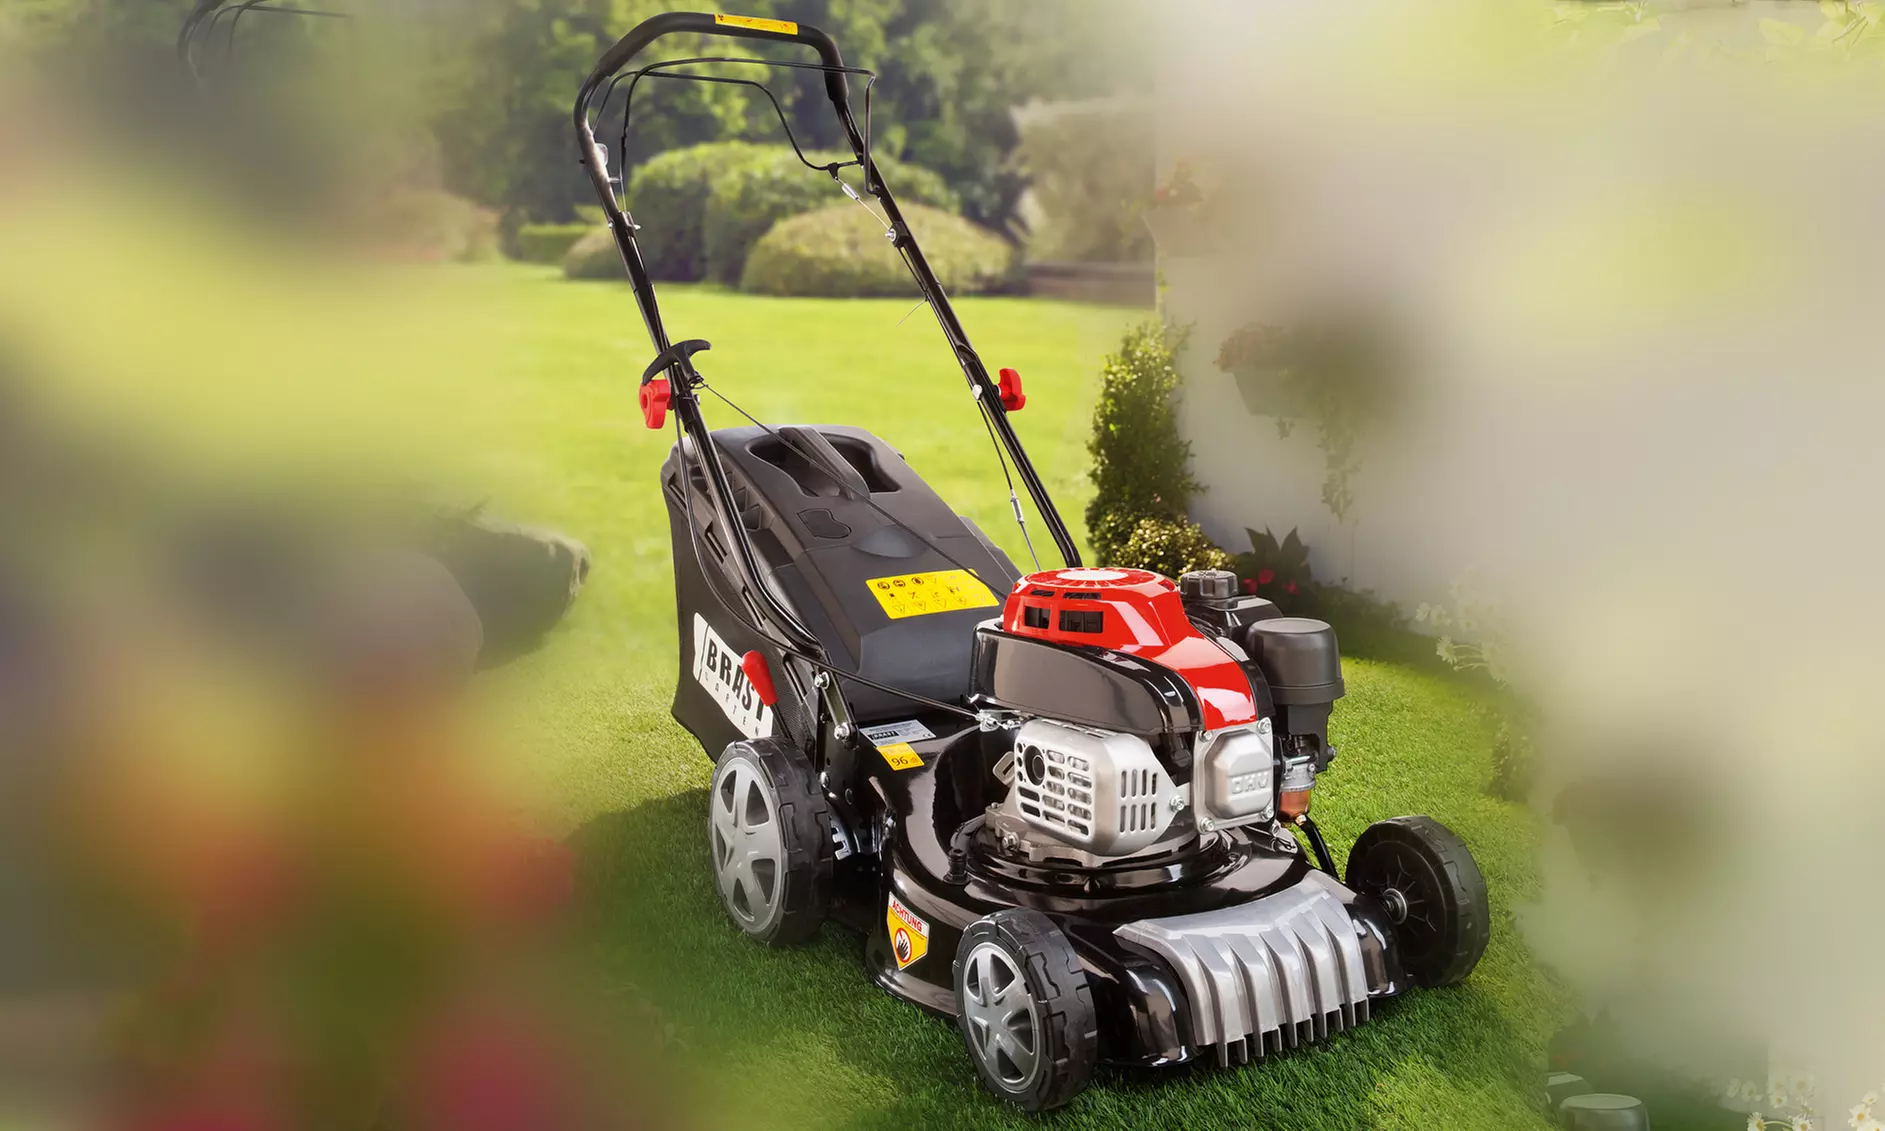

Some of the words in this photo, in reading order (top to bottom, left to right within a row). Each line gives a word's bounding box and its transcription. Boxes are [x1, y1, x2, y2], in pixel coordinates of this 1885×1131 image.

[891, 756, 909, 766] 96
[1231, 771, 1269, 795] OHV
[892, 900, 923, 932] ACHTUNG
